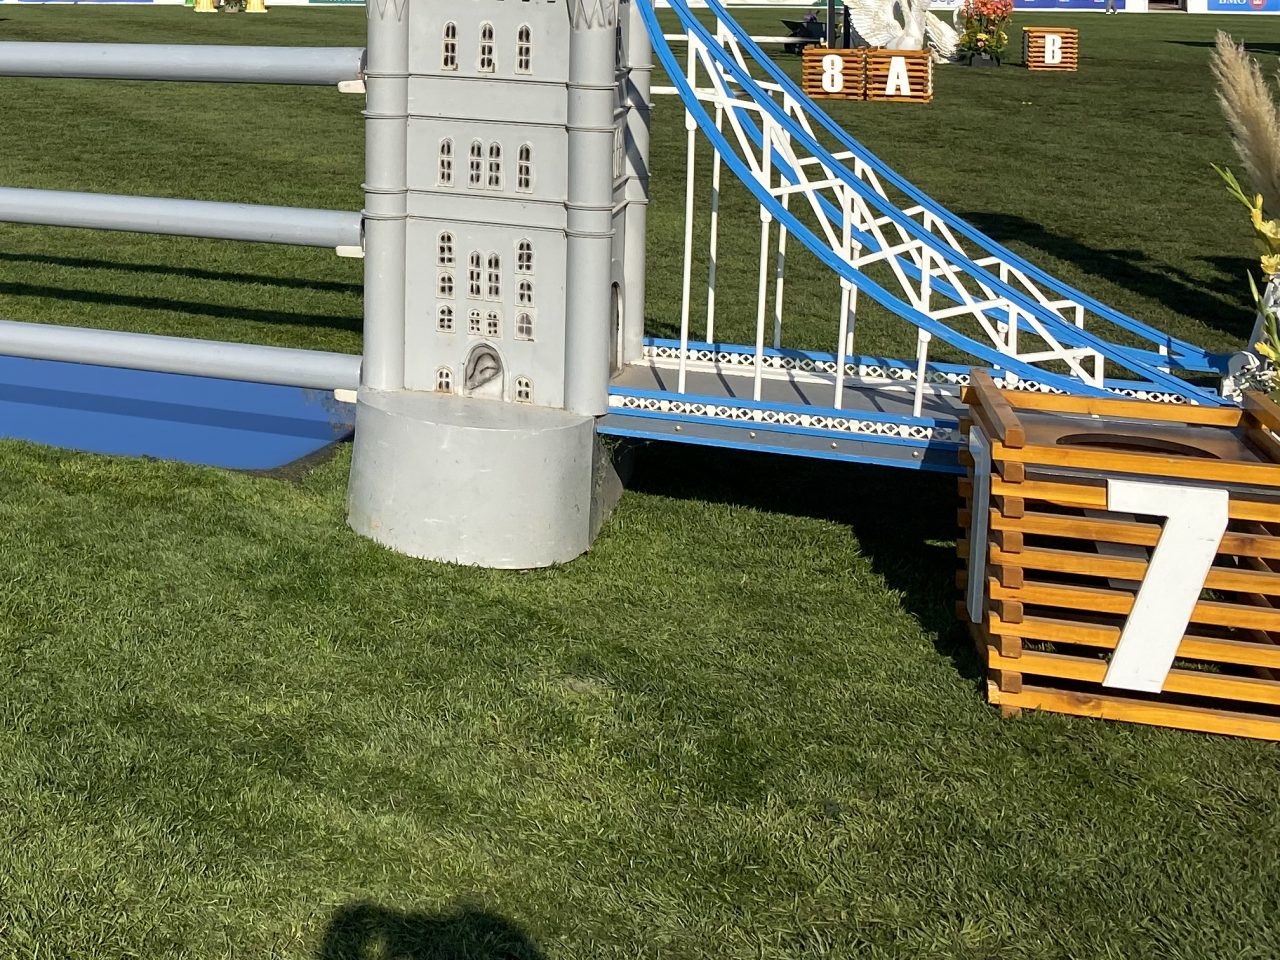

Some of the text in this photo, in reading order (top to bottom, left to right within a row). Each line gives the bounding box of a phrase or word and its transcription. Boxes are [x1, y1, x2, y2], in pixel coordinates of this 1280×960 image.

[1044, 34, 1062, 65] B
[821, 54, 912, 96] 8 A
[1102, 478, 1229, 694] 7
